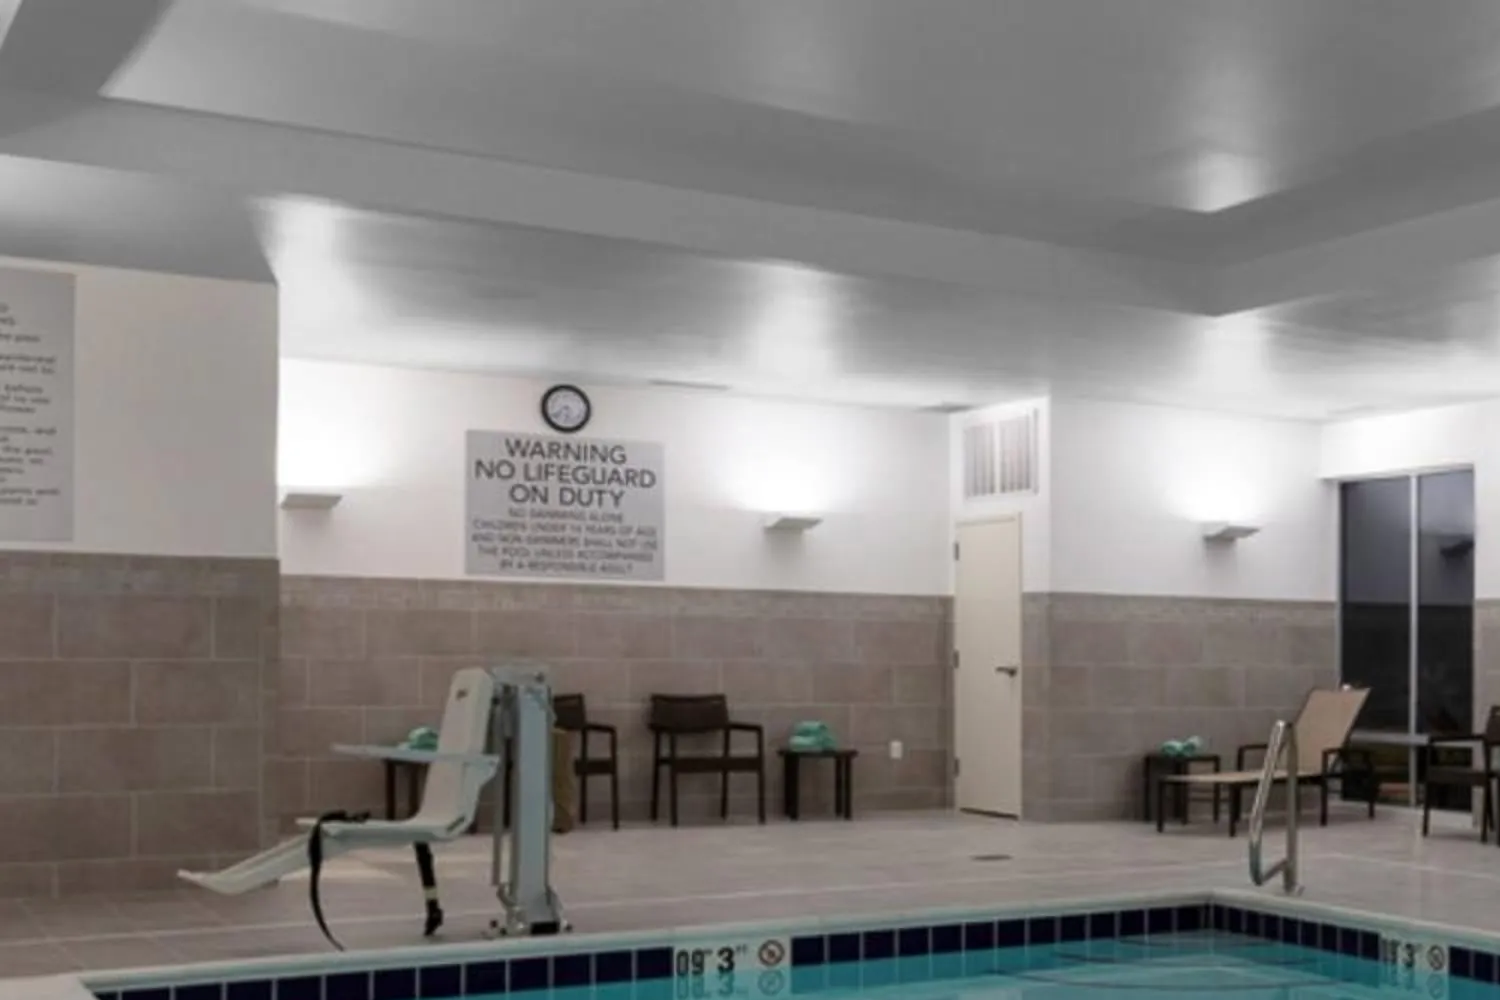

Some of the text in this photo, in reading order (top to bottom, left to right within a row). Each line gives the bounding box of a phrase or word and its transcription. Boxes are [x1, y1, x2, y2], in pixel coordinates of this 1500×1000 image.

[505, 438, 627, 465] WARNING
[475, 459, 656, 488] NO LIFEGUARD
[509, 484, 625, 508] ON DUTY
